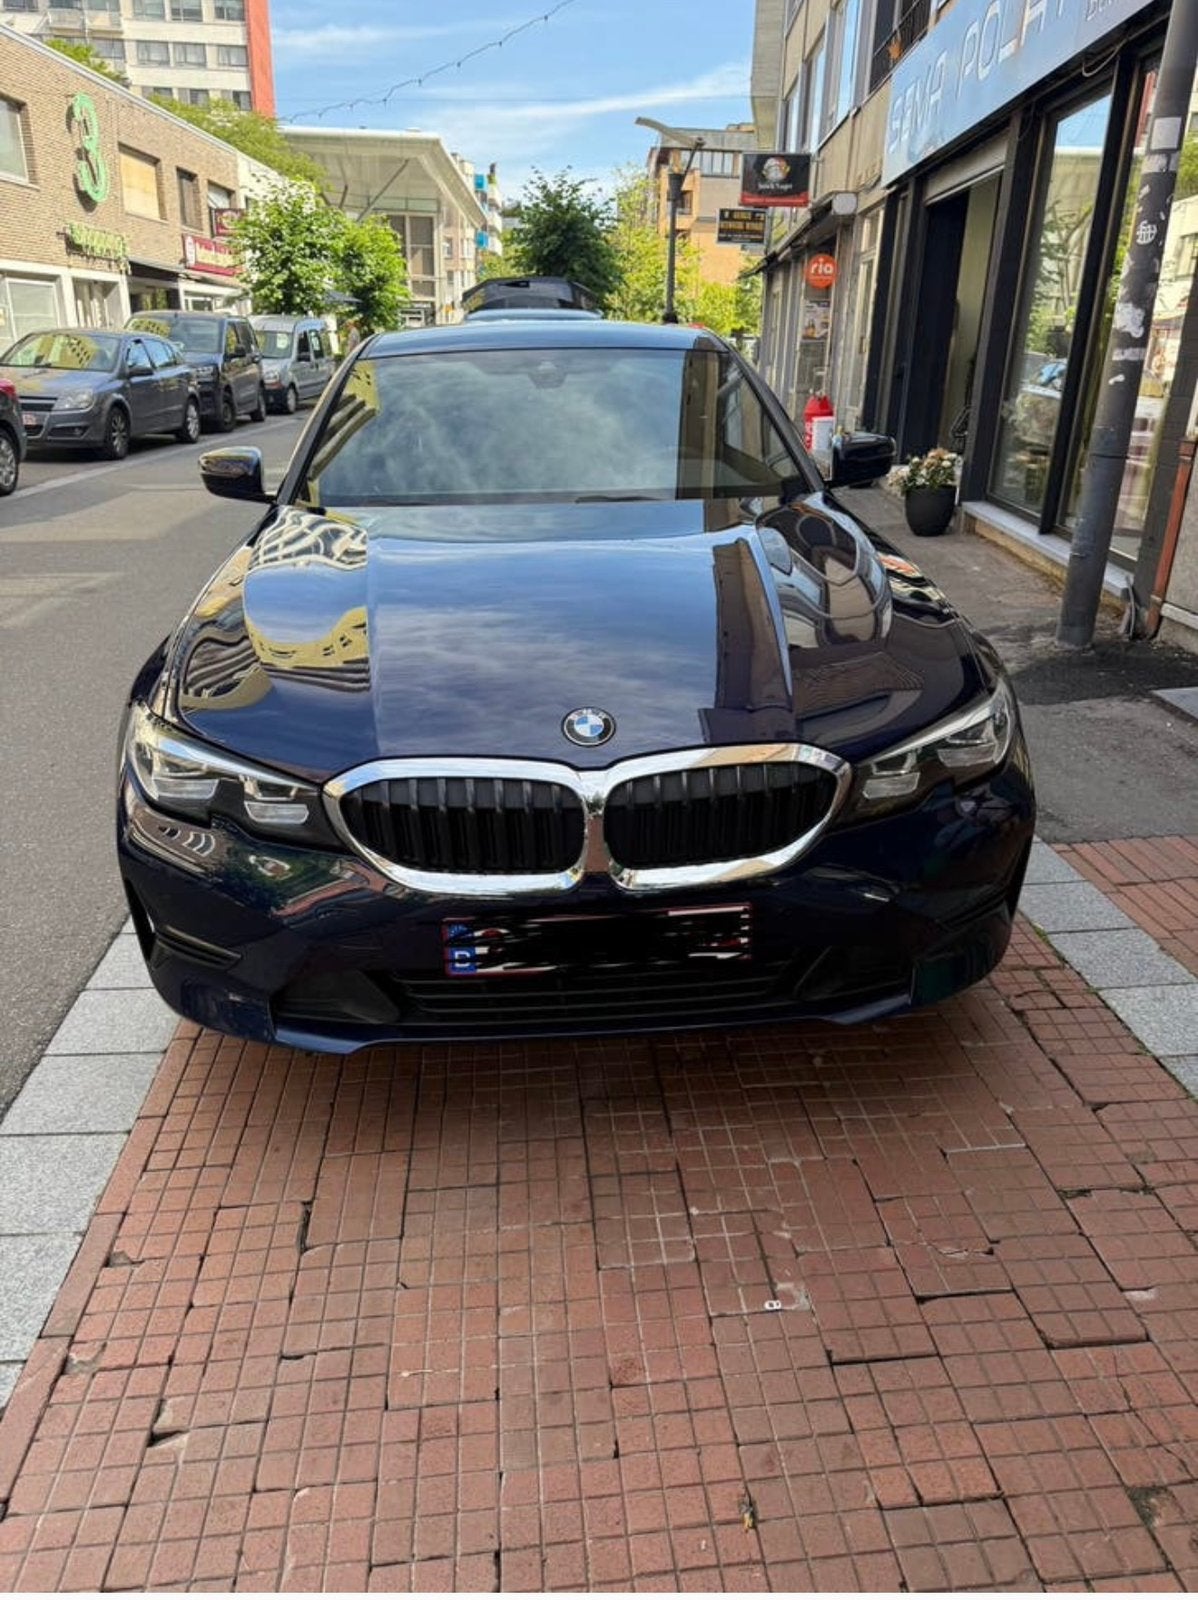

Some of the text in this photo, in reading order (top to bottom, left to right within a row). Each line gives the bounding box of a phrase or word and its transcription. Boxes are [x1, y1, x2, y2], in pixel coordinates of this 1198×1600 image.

[889, 0, 1065, 155] SEMA POLA
[73, 92, 109, 204] 3
[810, 258, 834, 275] ria
